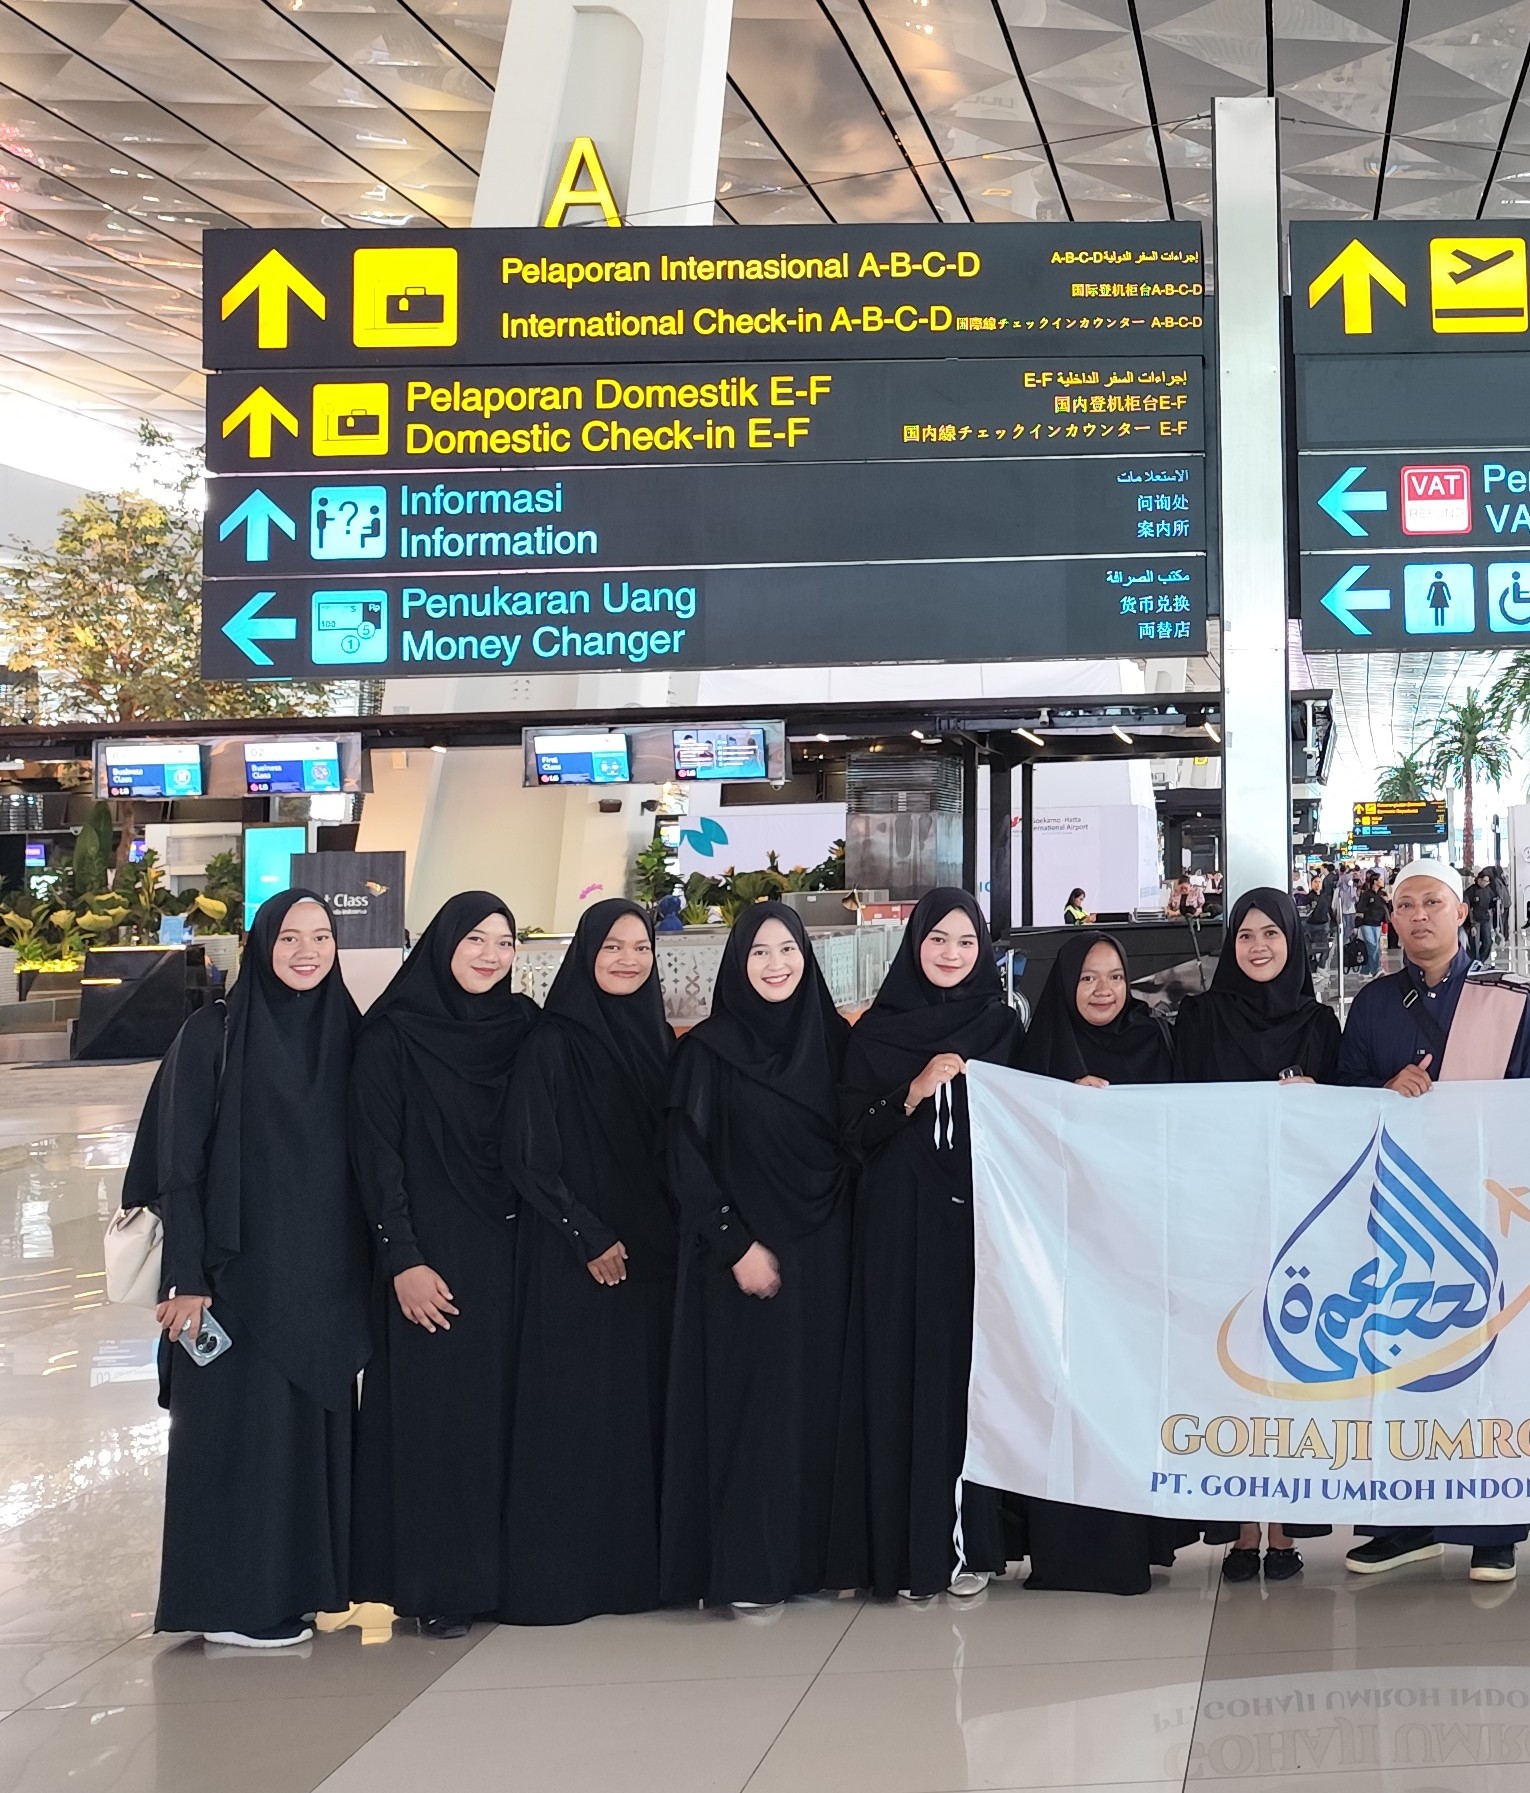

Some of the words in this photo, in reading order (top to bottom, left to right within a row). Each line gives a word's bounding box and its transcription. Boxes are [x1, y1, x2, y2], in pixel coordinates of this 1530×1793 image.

[544, 137, 625, 228] A
[502, 257, 651, 290] Pelaporan
[661, 252, 849, 281] Internasional
[857, 251, 981, 278] A-B-C-D
[502, 309, 684, 339] International
[693, 307, 823, 335] Check-in
[829, 305, 953, 332] A-B-C-D
[1150, 316, 1203, 329] A-B-C-D
[1023, 372, 1053, 388] E-F
[406, 381, 583, 419] Pelaporan
[596, 376, 759, 409] Domestik
[770, 375, 832, 406] E-F
[406, 422, 571, 454] Domestic
[581, 419, 735, 452] Check-in
[748, 417, 811, 448] E-F
[1159, 421, 1188, 437] E-F
[1410, 474, 1461, 496] VAT
[401, 482, 562, 516] Informasi
[1137, 494, 1190, 512] 问询处
[400, 524, 598, 558] Information
[1137, 519, 1190, 538] 案内所
[1106, 570, 1154, 587] الصرافة
[1157, 569, 1190, 584] مكتب
[402, 585, 590, 619] Penukaran
[603, 581, 696, 619] Uang
[1120, 595, 1191, 614] 货币兑换
[1138, 621, 1191, 640] 両替店
[402, 629, 522, 666] Money
[532, 625, 687, 663] Changer
[333, 893, 369, 907] Class
[1160, 1413, 1373, 1471] GOHAJI
[1150, 1471, 1193, 1496] PT.
[1200, 1474, 1312, 1504] GOHAJI
[1321, 1477, 1435, 1501] UMROH
